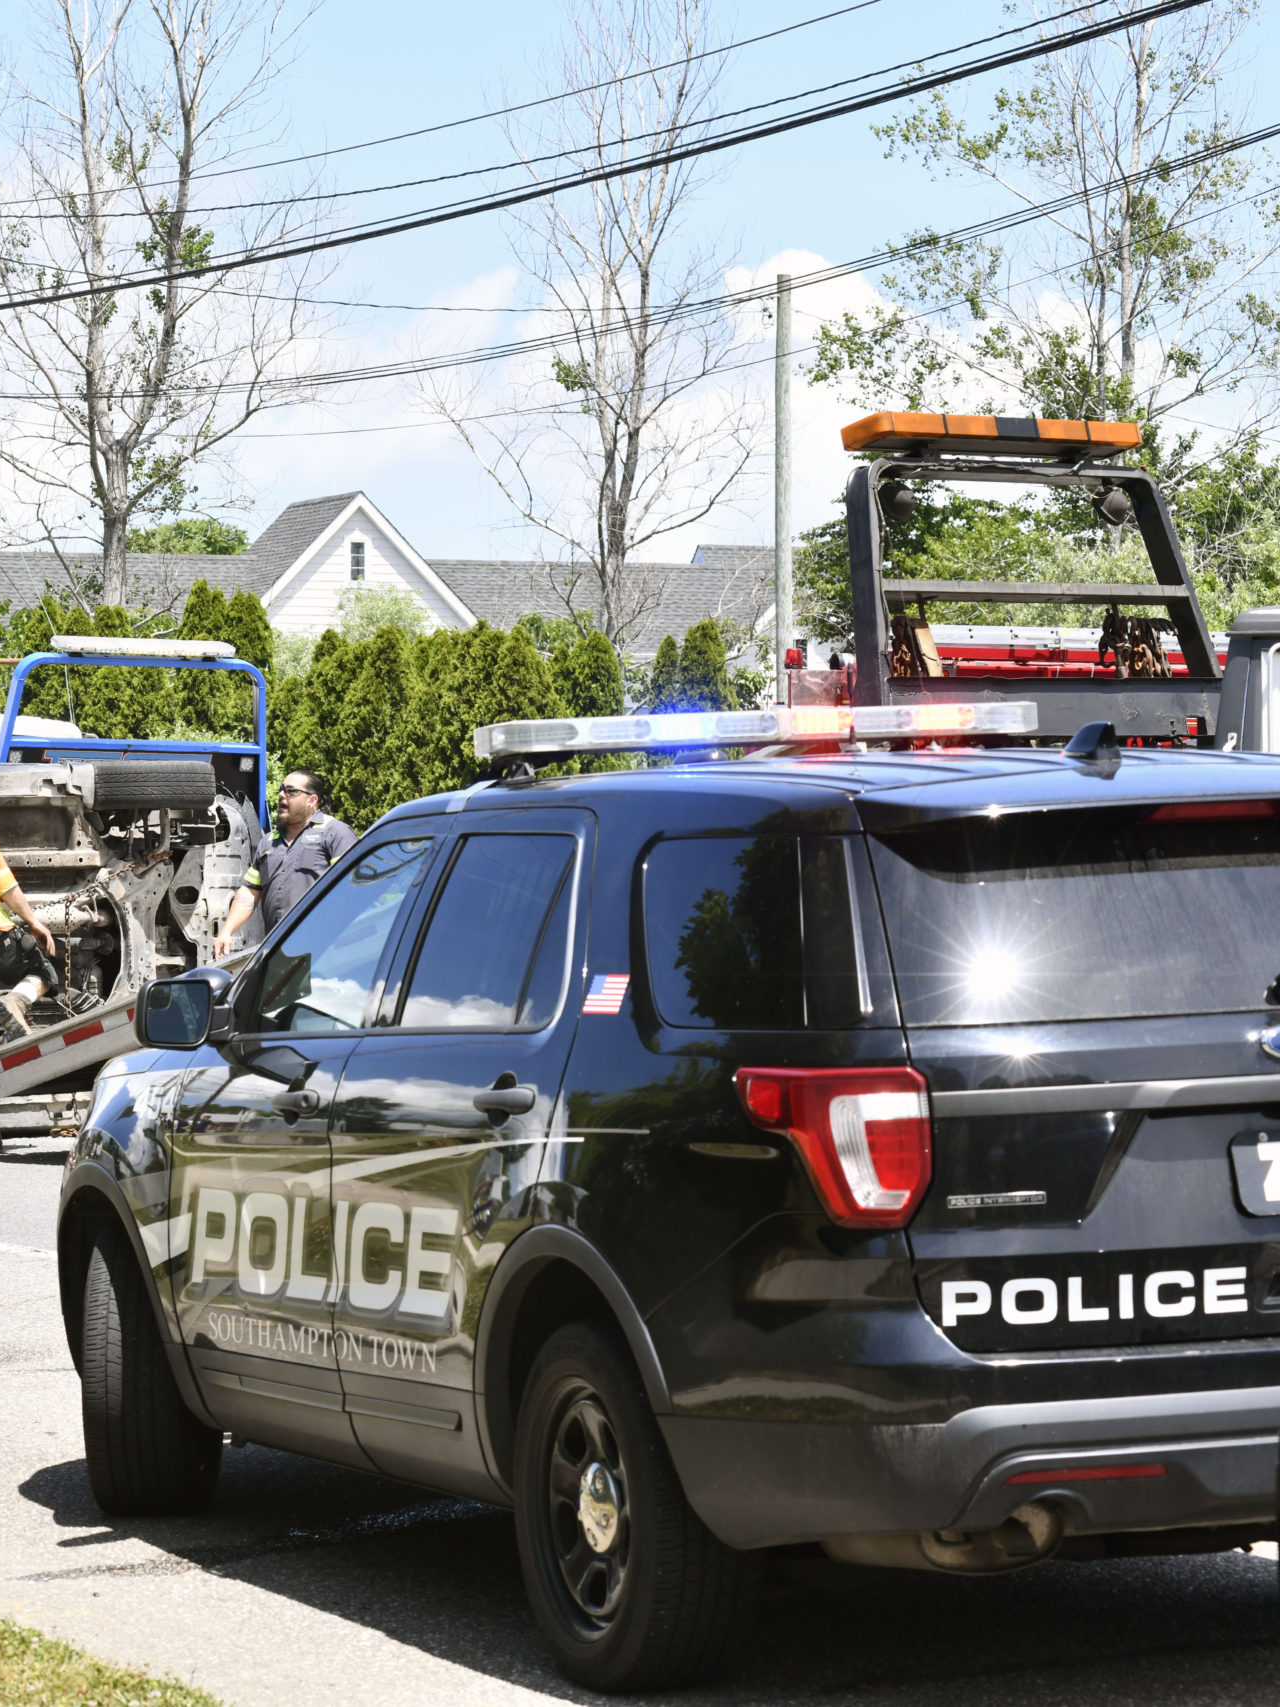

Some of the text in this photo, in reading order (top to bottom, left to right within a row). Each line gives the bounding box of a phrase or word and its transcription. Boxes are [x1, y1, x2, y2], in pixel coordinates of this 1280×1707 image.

[950, 1197, 981, 1207] POLICE
[191, 1187, 459, 1318] POLICE
[941, 1266, 1249, 1327] POLICE
[208, 1311, 438, 1374] SOUTHAMPTON TOWN
